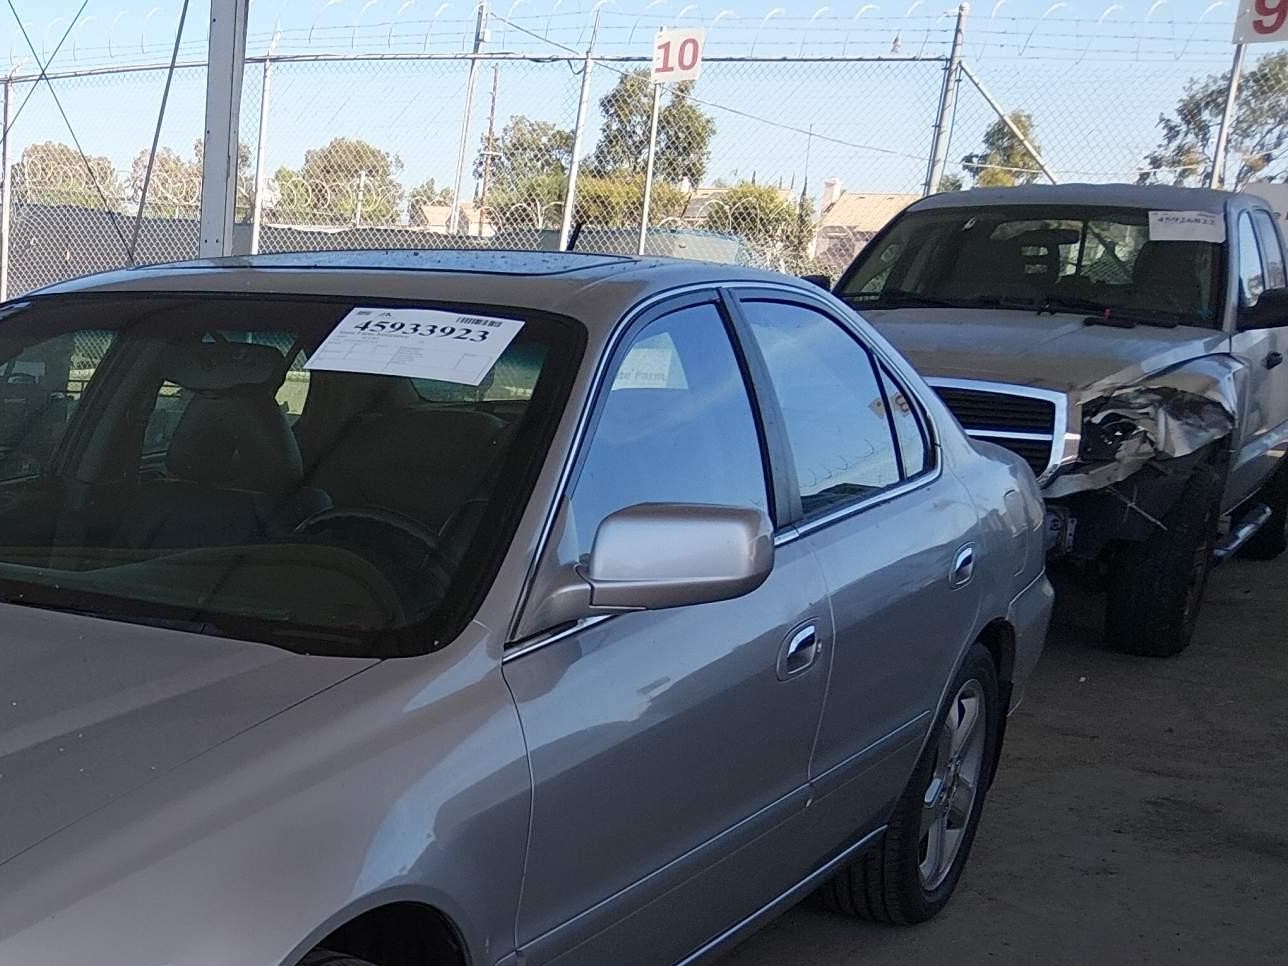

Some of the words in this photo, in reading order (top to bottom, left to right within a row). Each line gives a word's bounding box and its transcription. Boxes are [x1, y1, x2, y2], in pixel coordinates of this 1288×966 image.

[1253, 0, 1288, 35] 9
[655, 38, 700, 73] 10
[354, 320, 490, 342] 45933923
